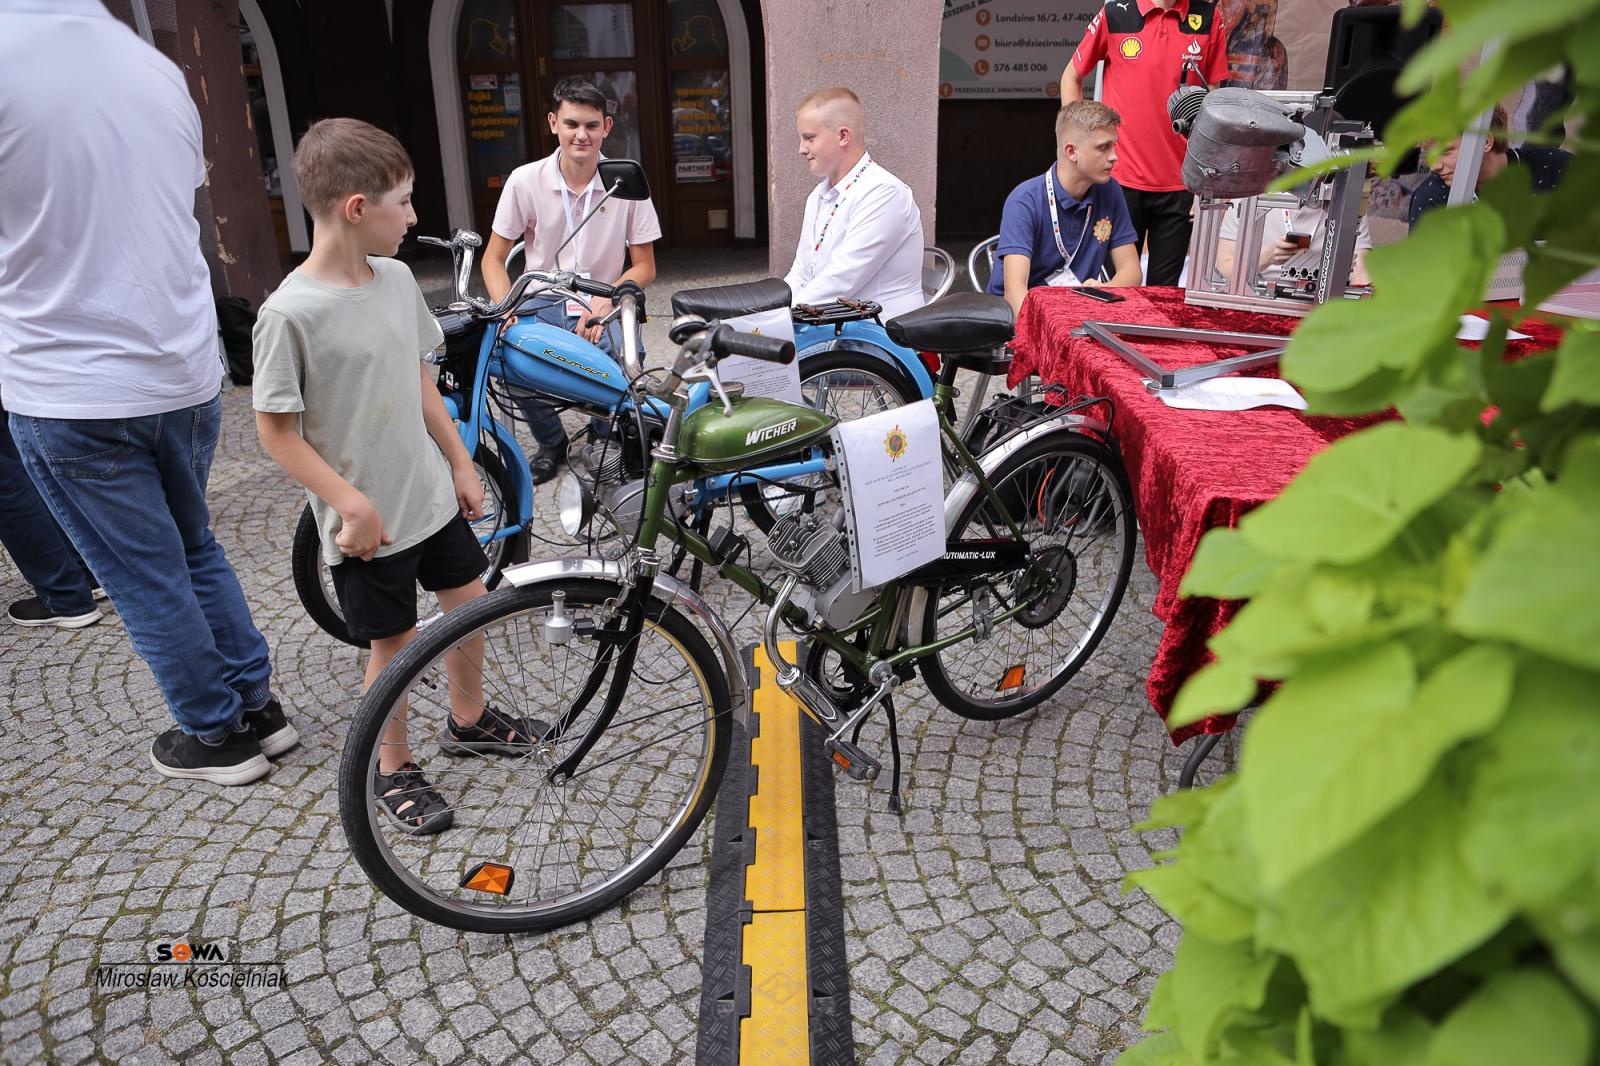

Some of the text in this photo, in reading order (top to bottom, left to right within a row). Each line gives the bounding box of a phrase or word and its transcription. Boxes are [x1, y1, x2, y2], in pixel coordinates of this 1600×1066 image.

[1062, 13, 1093, 22] 47-400
[993, 63, 1048, 72] 576 485 006
[677, 164, 713, 173] PARTNER
[745, 417, 798, 446] WICHER
